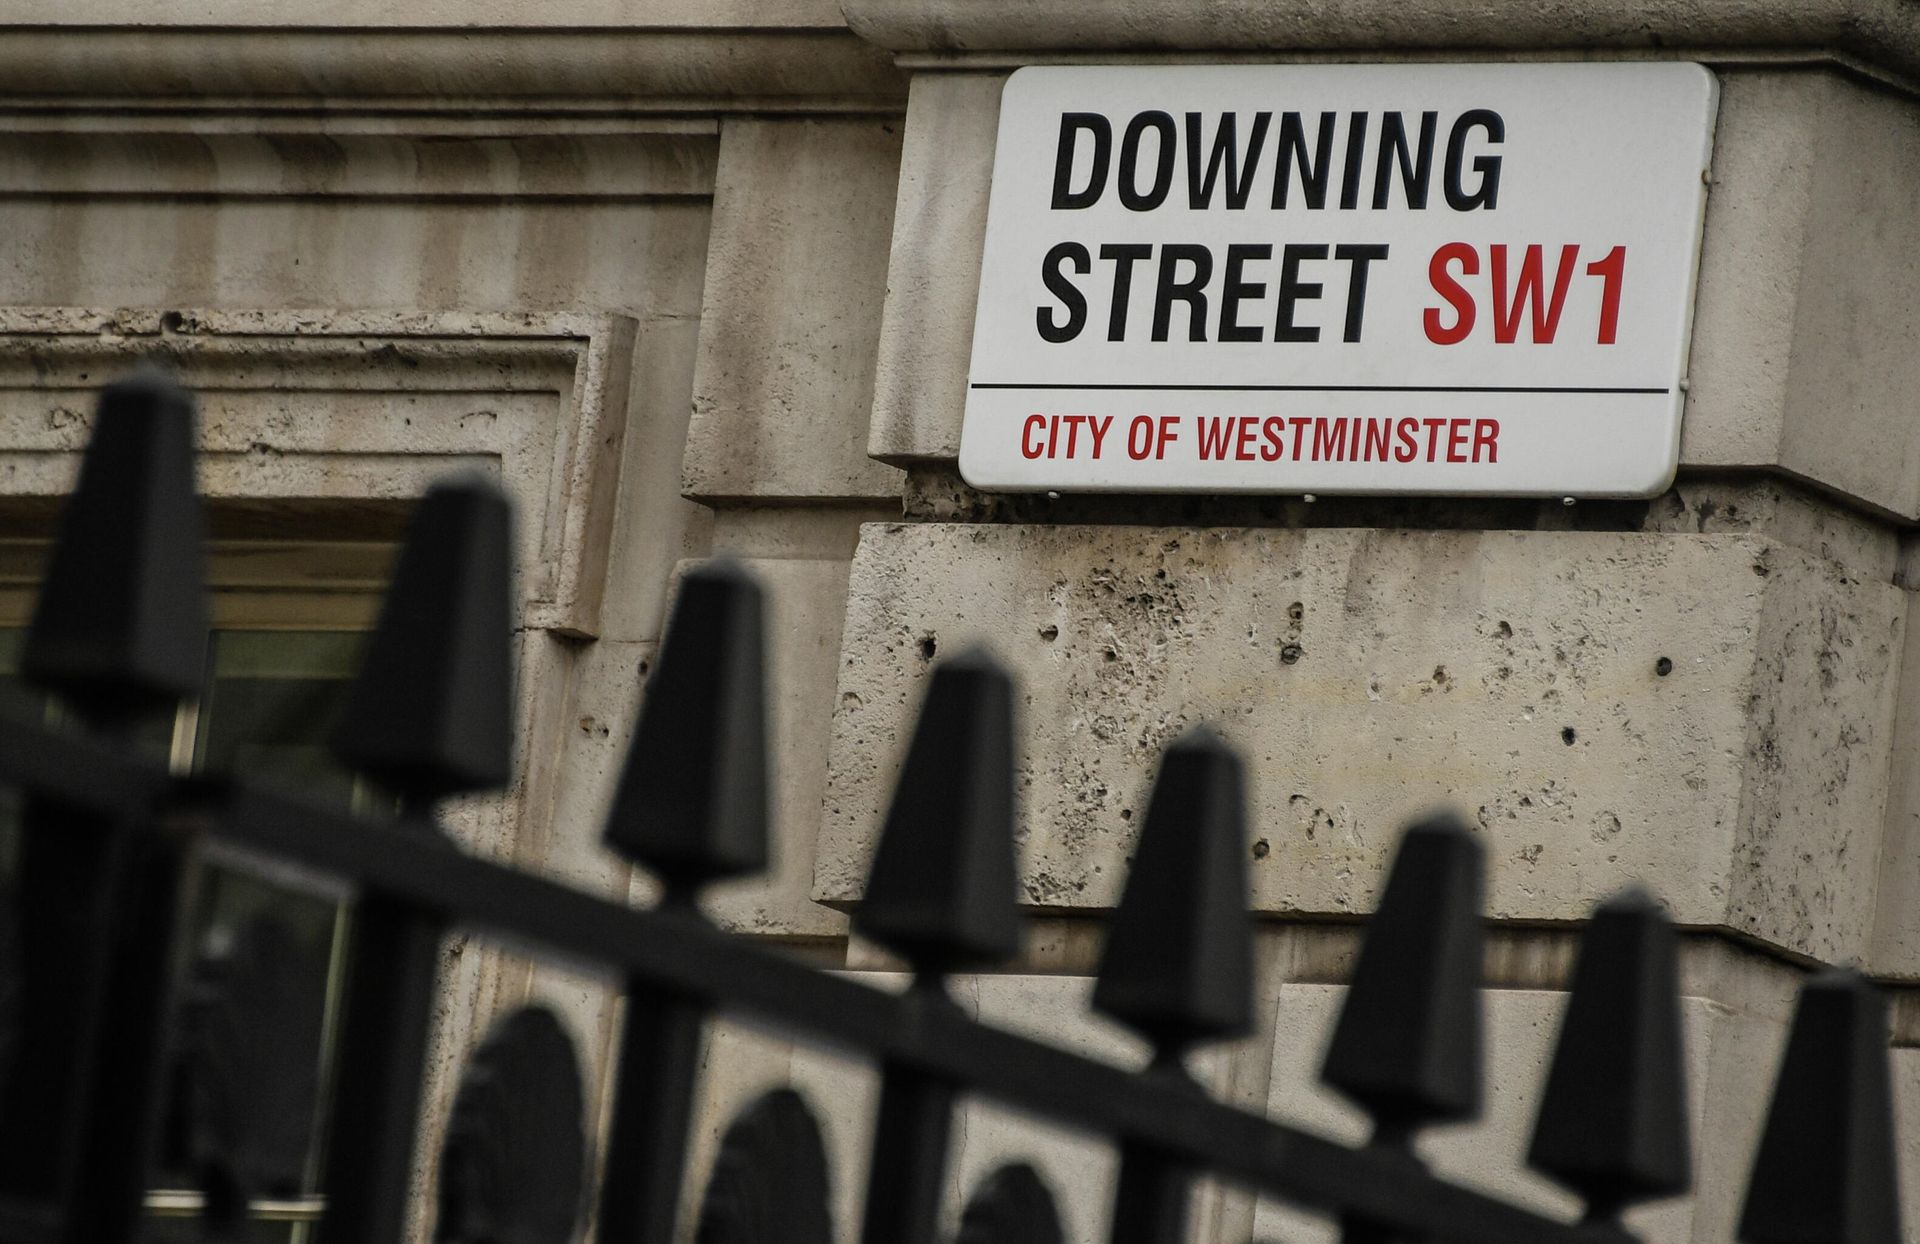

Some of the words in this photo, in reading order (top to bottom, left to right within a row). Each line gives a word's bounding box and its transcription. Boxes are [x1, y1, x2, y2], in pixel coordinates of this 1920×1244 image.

[1050, 108, 1506, 213] DOWNING
[1036, 241, 1390, 344] STREET
[1422, 241, 1627, 346] SW1
[1021, 414, 1115, 460] CITY
[1127, 415, 1181, 461] OF
[1197, 416, 1500, 464] WESTMINSTER
